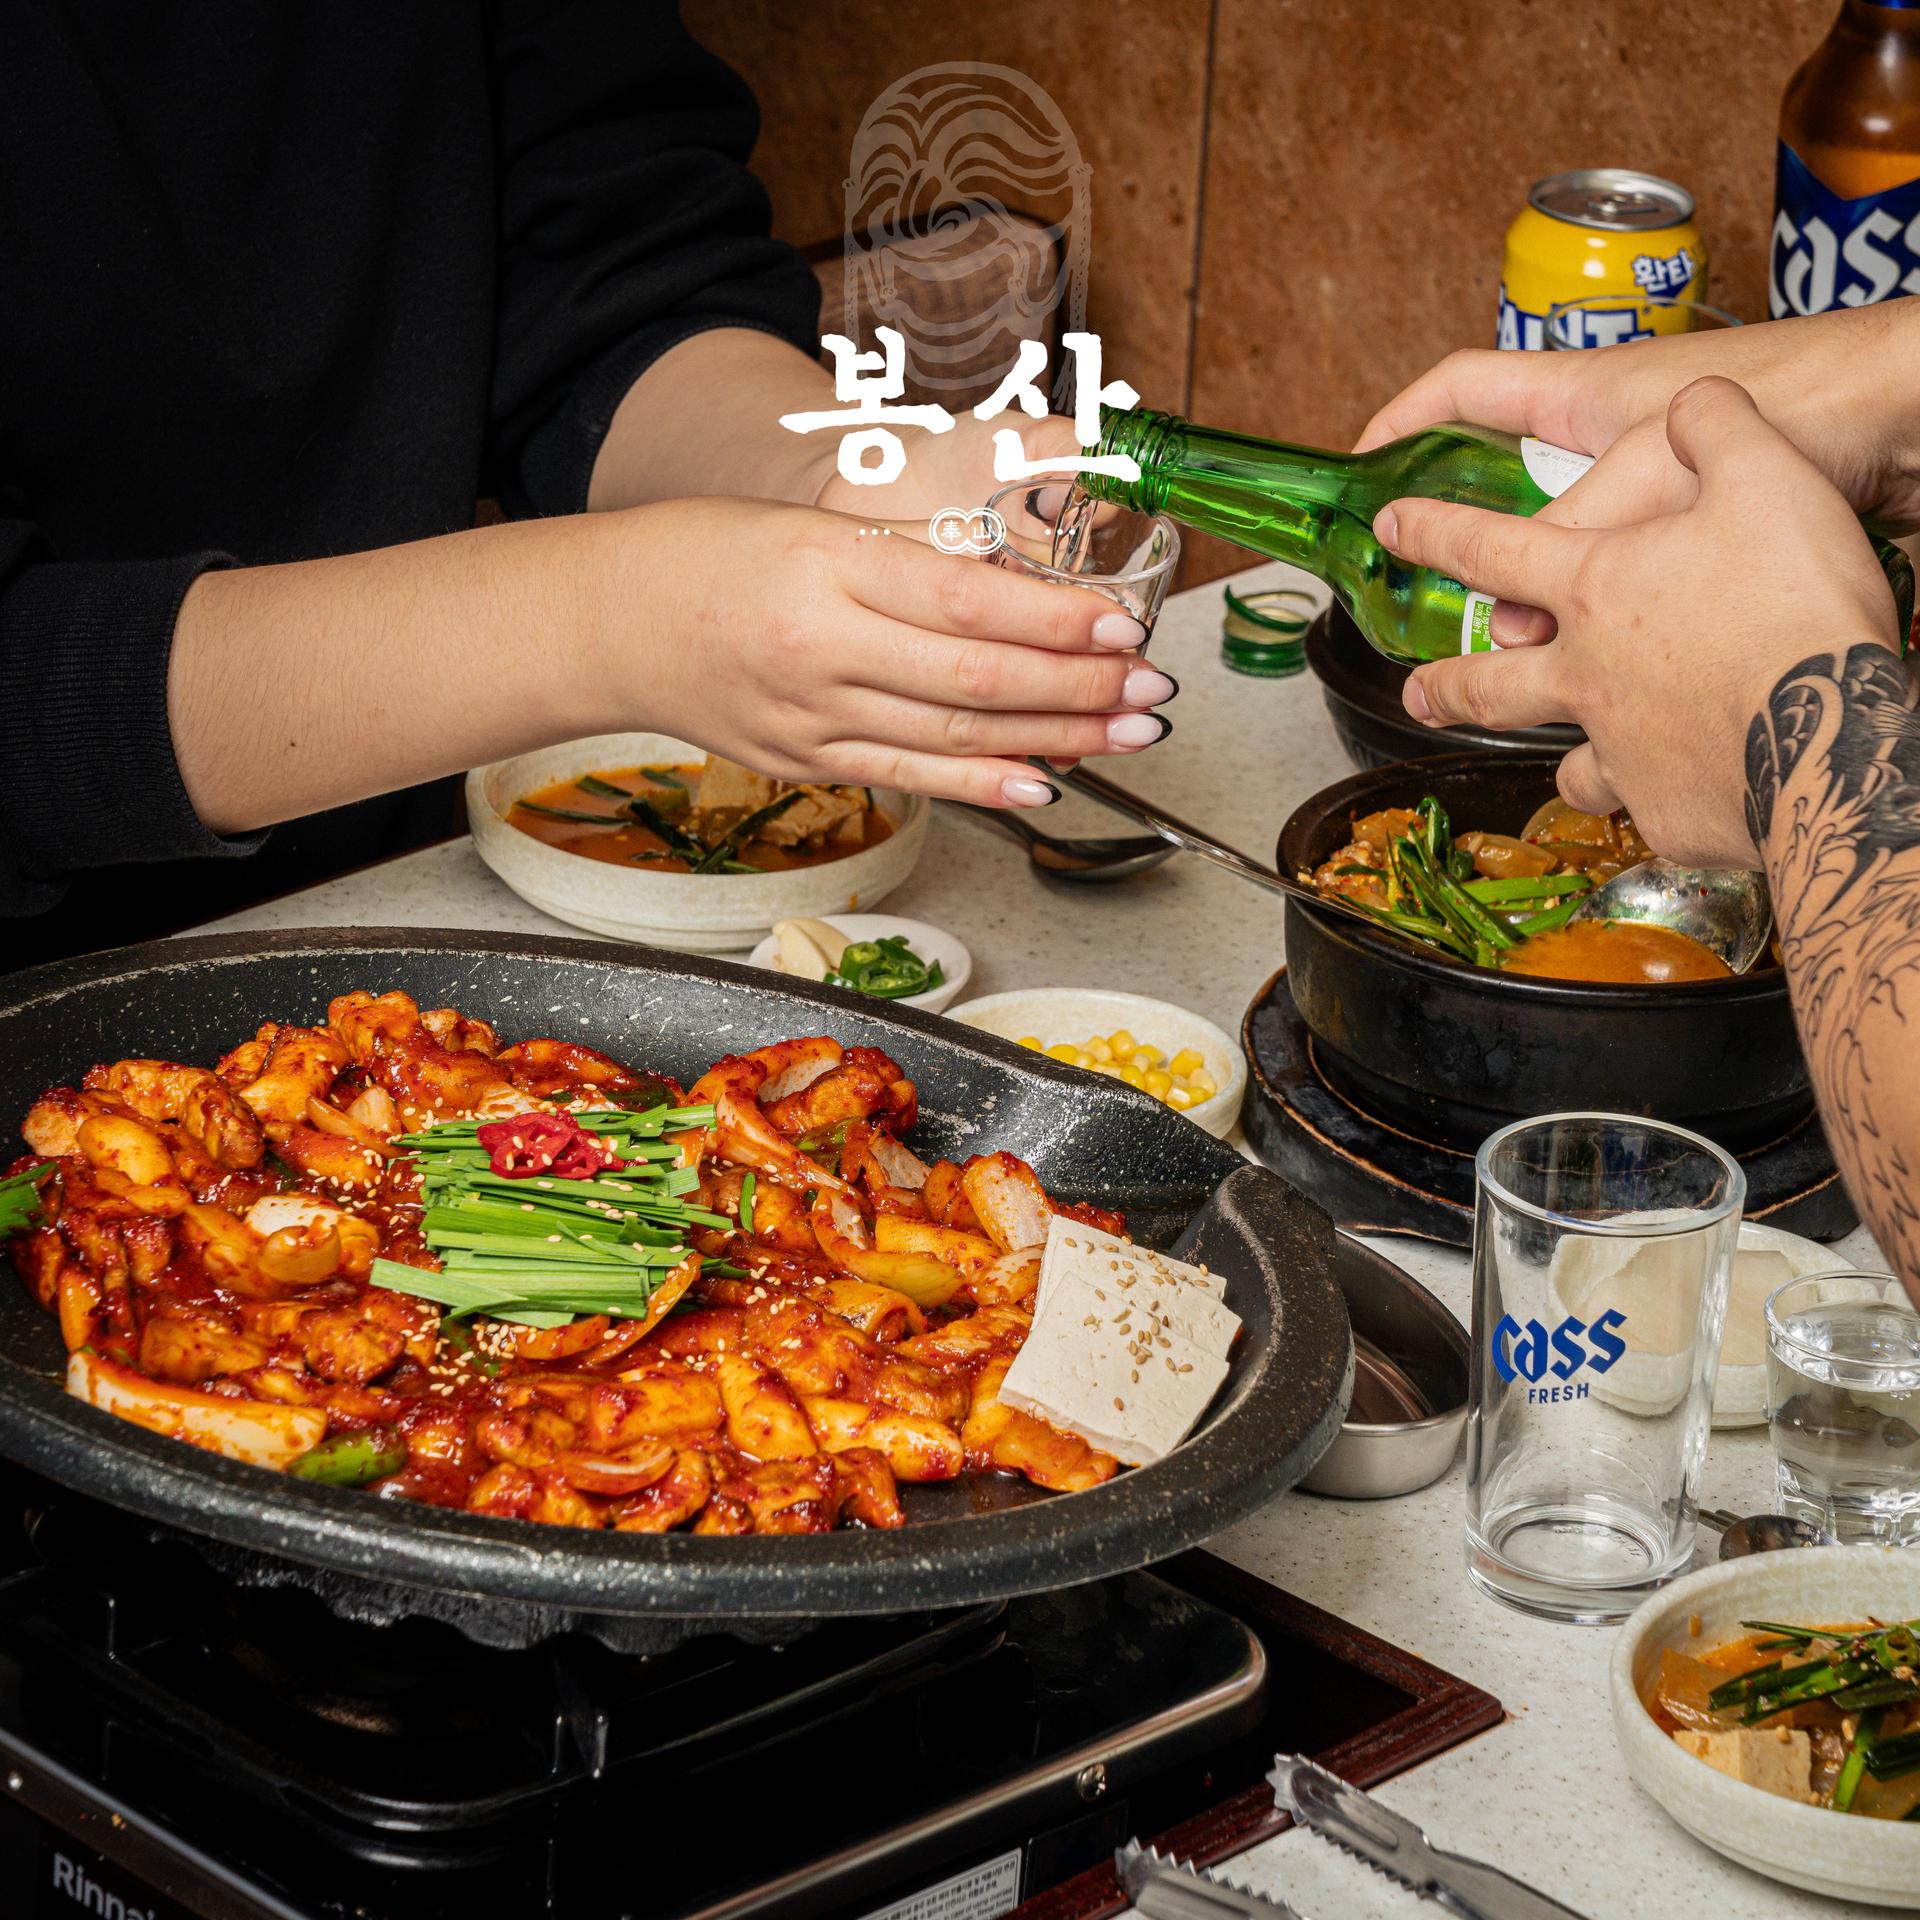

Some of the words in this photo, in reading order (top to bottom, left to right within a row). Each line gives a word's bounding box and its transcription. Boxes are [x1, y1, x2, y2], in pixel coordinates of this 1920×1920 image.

[1632, 248, 1694, 293] 환타
[1497, 286, 1656, 350] ANT
[1528, 1382, 1590, 1404] FRESH
[53, 1851, 156, 1920] Rinn
